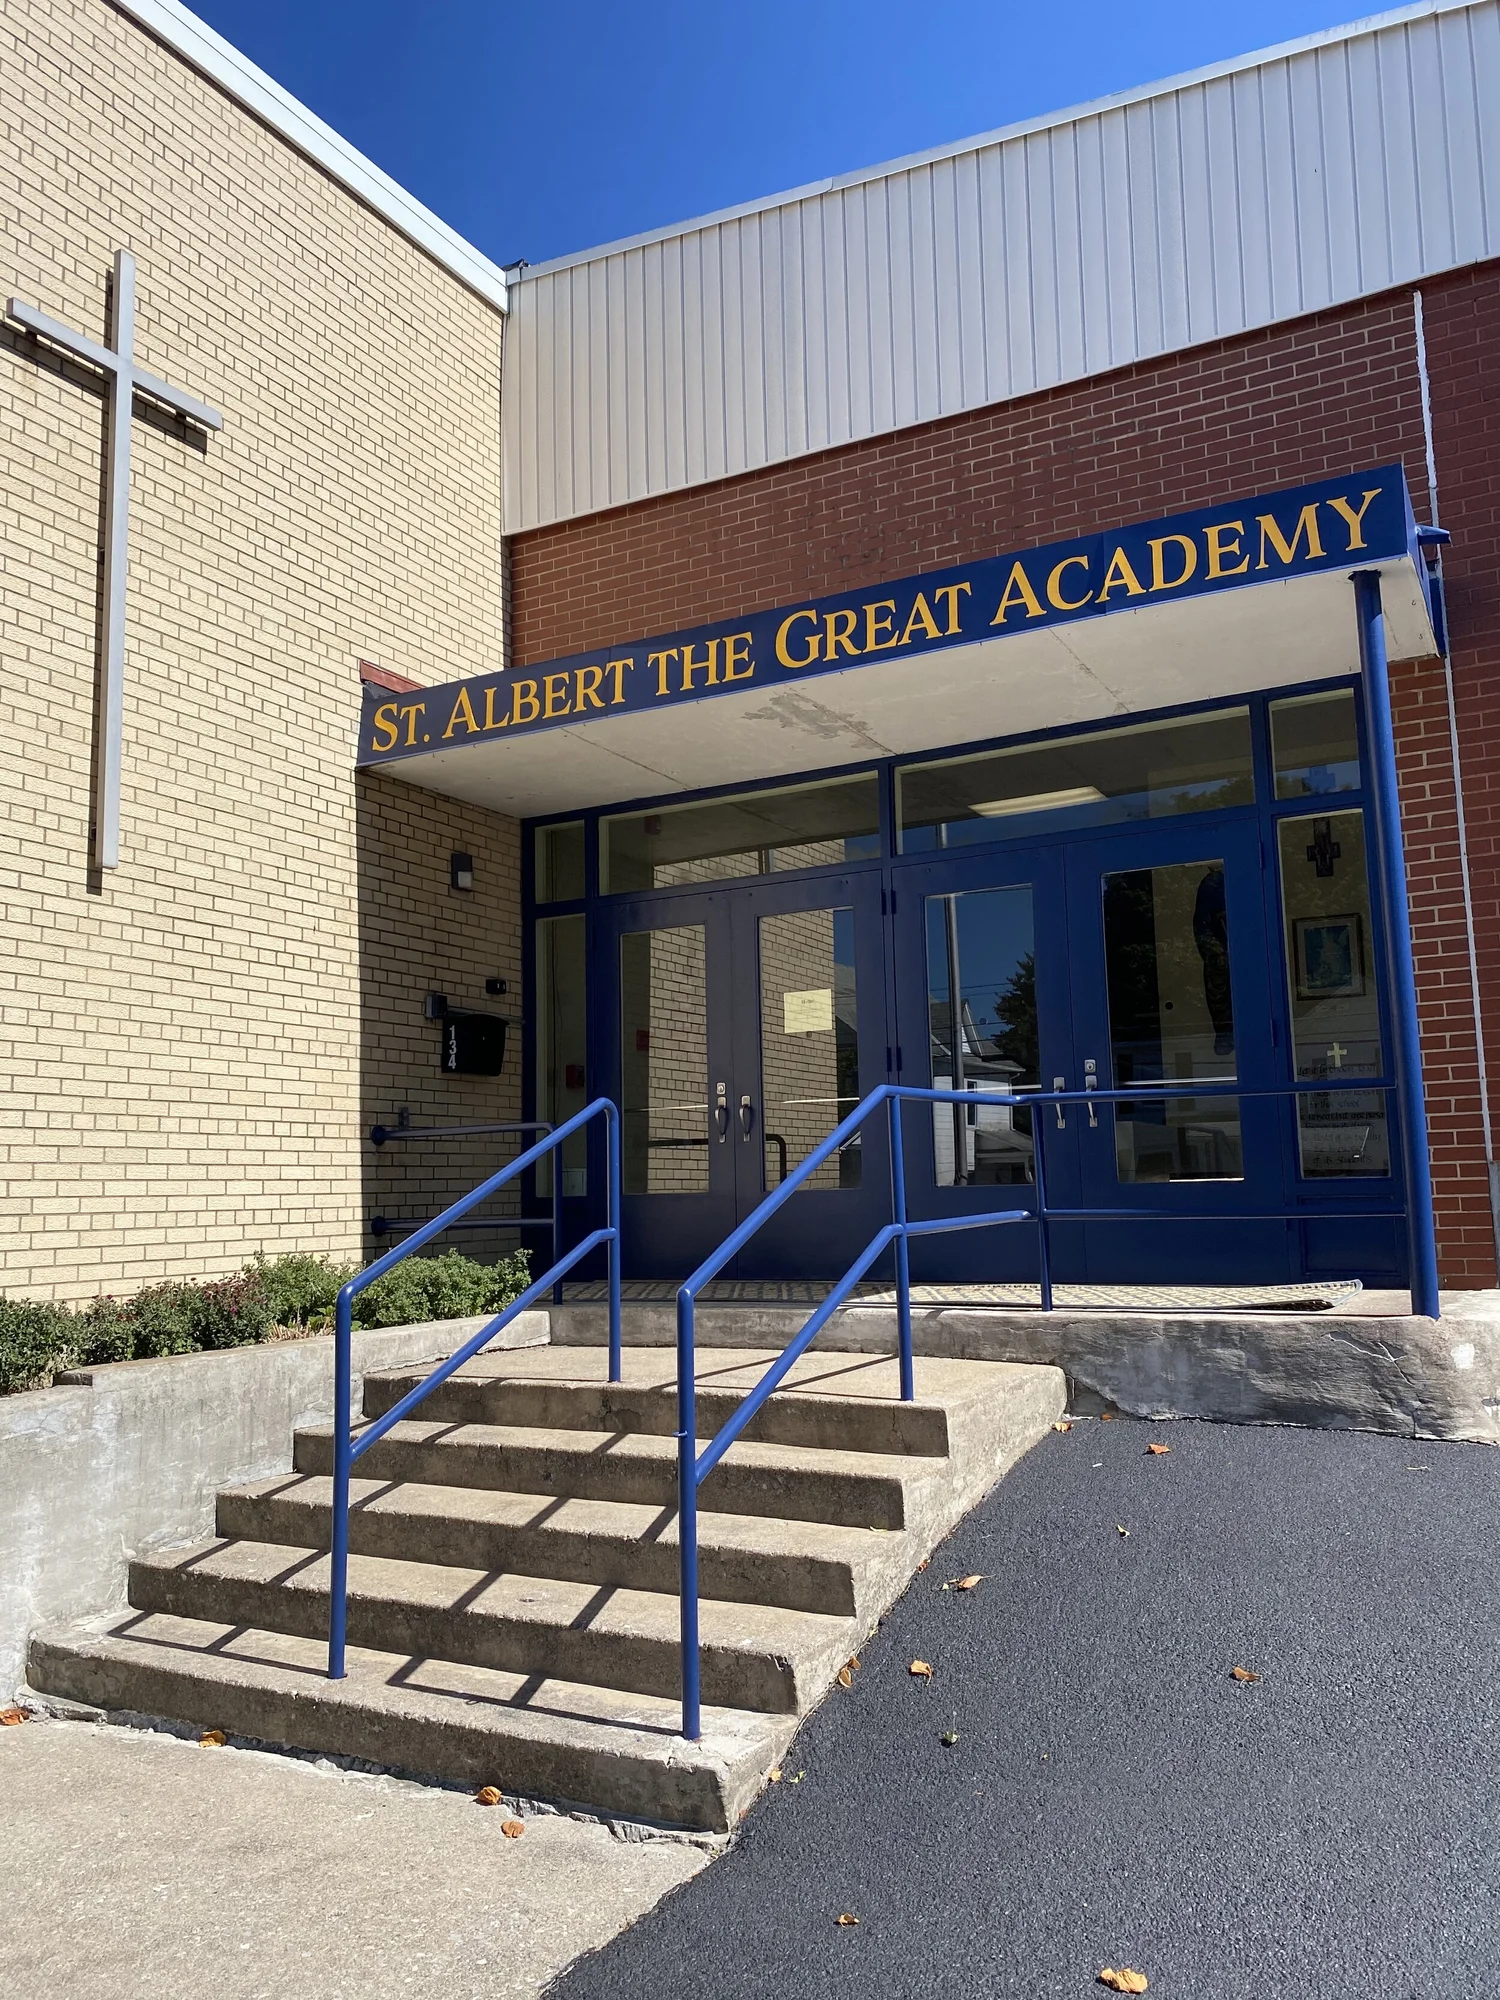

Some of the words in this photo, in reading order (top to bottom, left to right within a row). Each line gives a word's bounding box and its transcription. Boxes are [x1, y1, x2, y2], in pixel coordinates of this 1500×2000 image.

[372, 702, 432, 753] ST.
[442, 656, 635, 739] ALBERT
[647, 631, 756, 697] THE
[774, 581, 972, 669] GREAT
[989, 487, 1383, 626] ACADEMY
